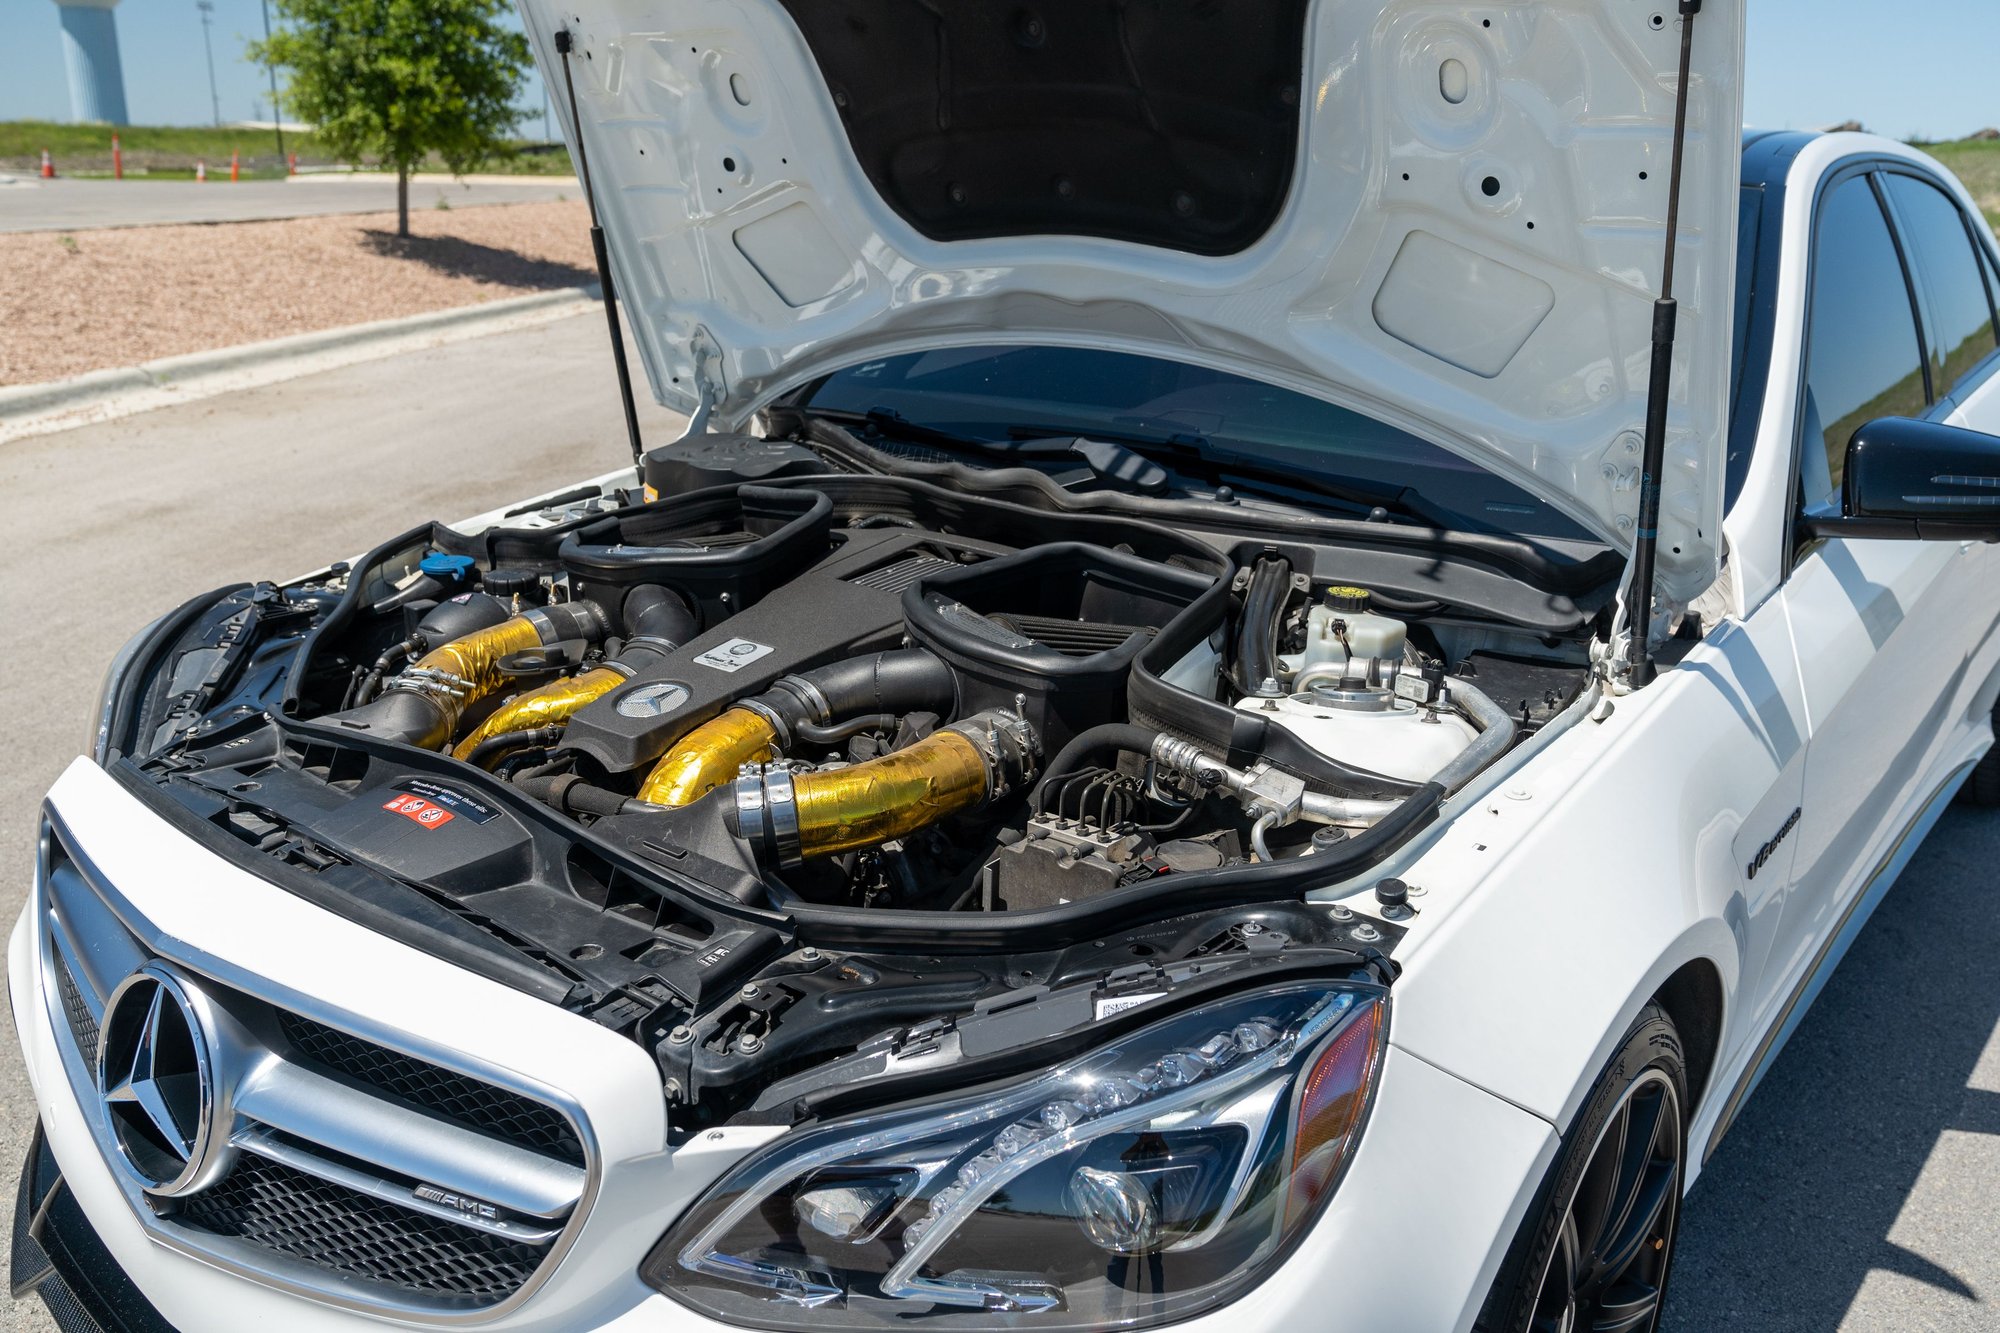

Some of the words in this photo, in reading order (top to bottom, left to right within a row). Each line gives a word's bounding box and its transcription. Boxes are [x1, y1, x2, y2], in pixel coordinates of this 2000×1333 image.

[441, 788, 463, 801] approves
[461, 797, 477, 807] these
[1559, 1163, 1573, 1194] PILOT
[1573, 1130, 1588, 1164] SPORT
[1588, 1113, 1598, 1130] ALL
[1597, 1082, 1614, 1112] SEASON
[440, 1194, 497, 1218] AMG
